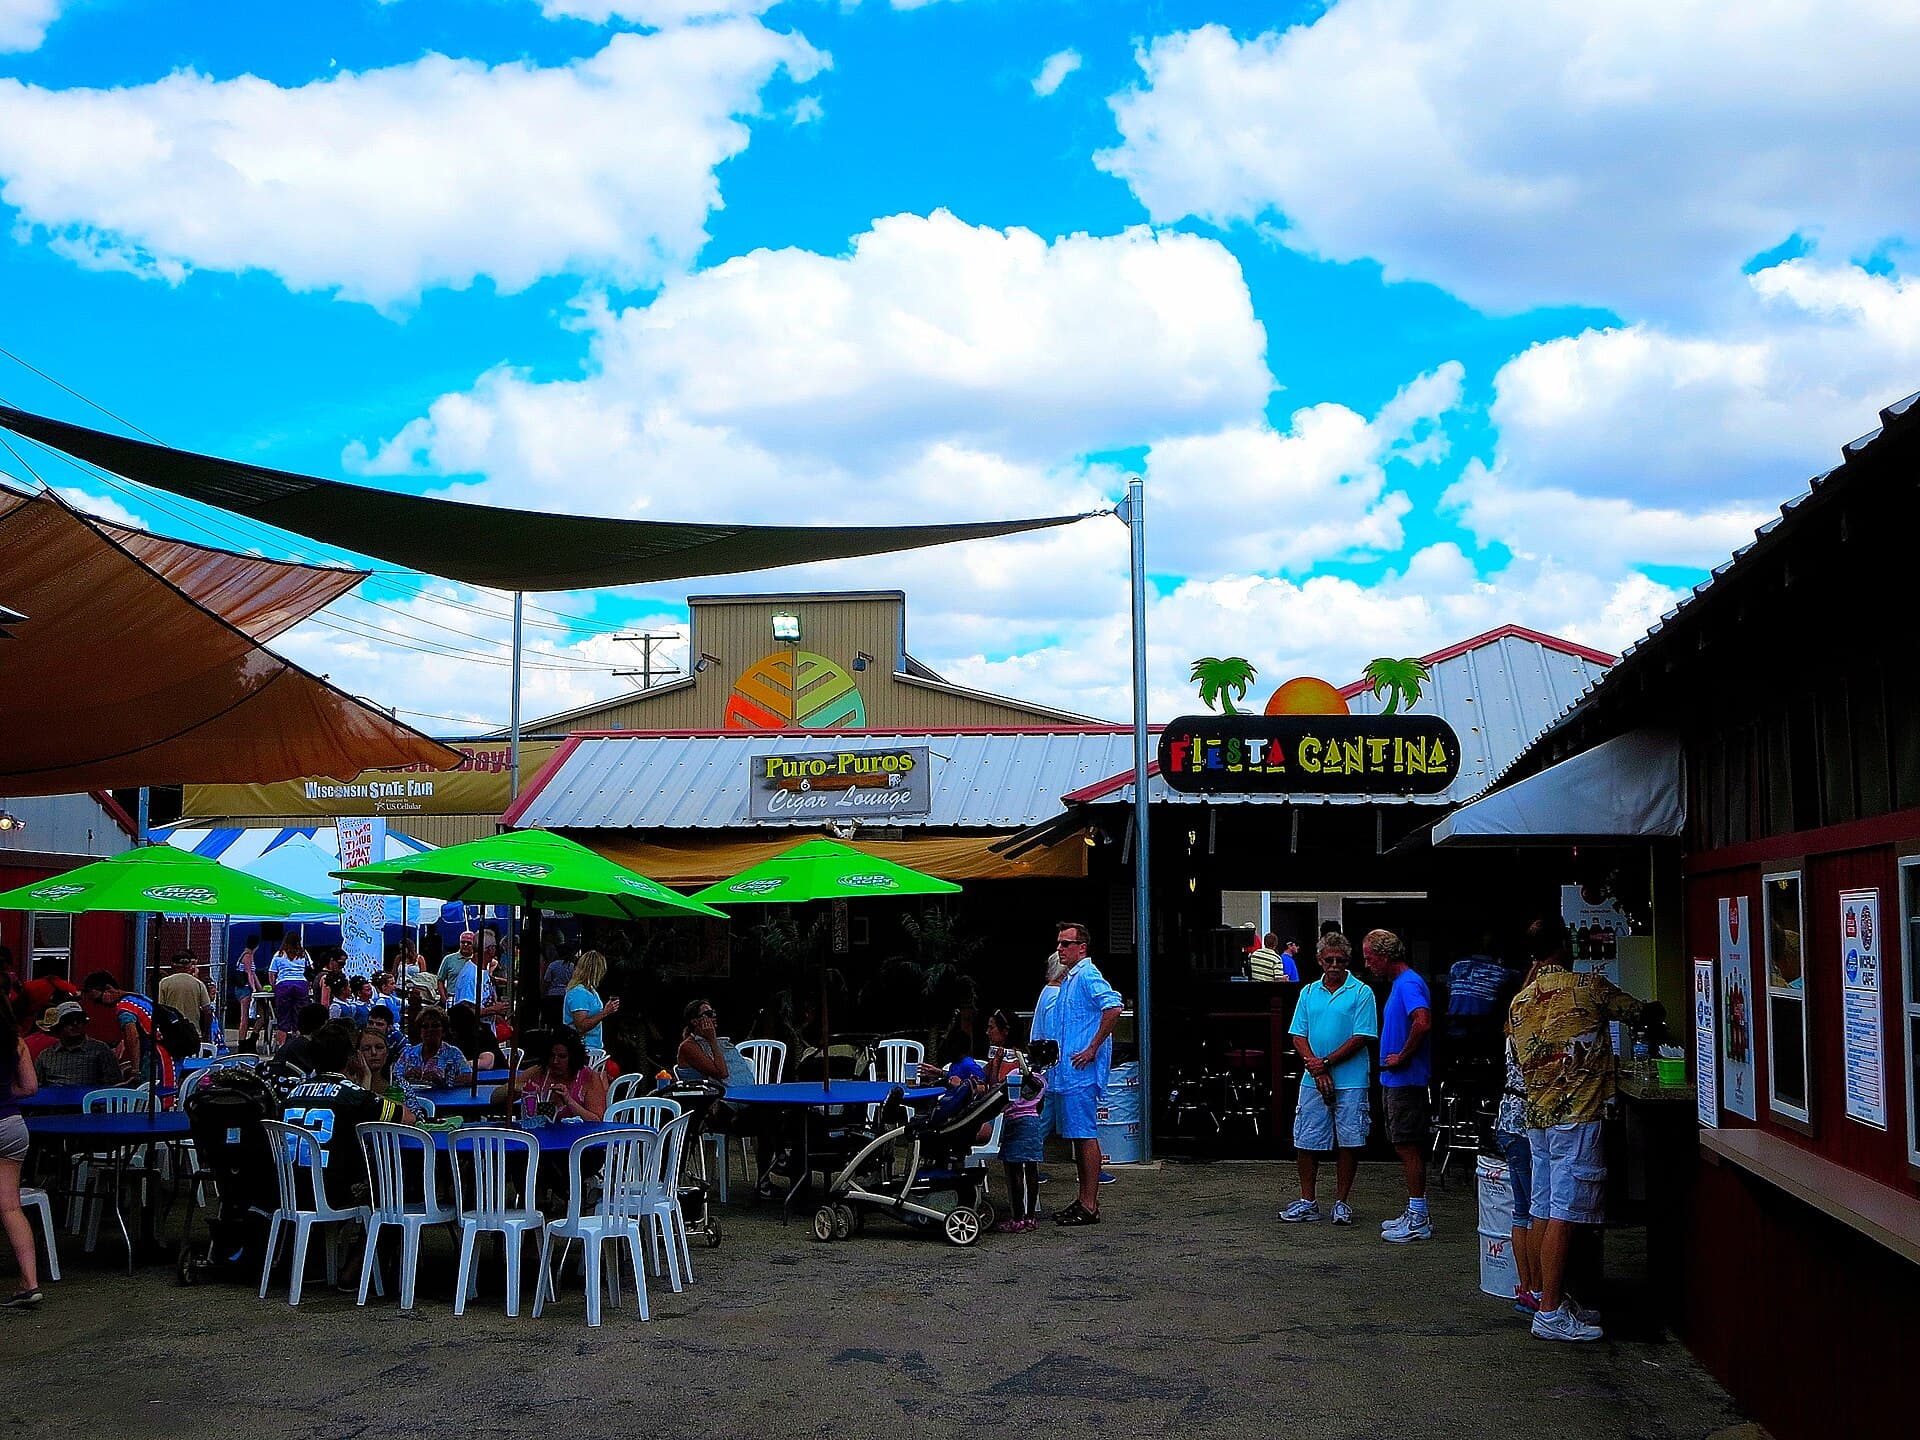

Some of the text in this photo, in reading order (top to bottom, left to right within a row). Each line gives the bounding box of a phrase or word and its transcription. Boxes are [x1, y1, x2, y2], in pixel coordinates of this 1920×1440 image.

[766, 753, 913, 778] Puro-Puros
[1170, 735, 1447, 774] FIESTA CANTINA
[370, 781, 405, 799] STATE
[408, 780, 433, 796] FAIR
[767, 785, 912, 816] Cigar Lounge
[283, 1107, 335, 1168] 52
